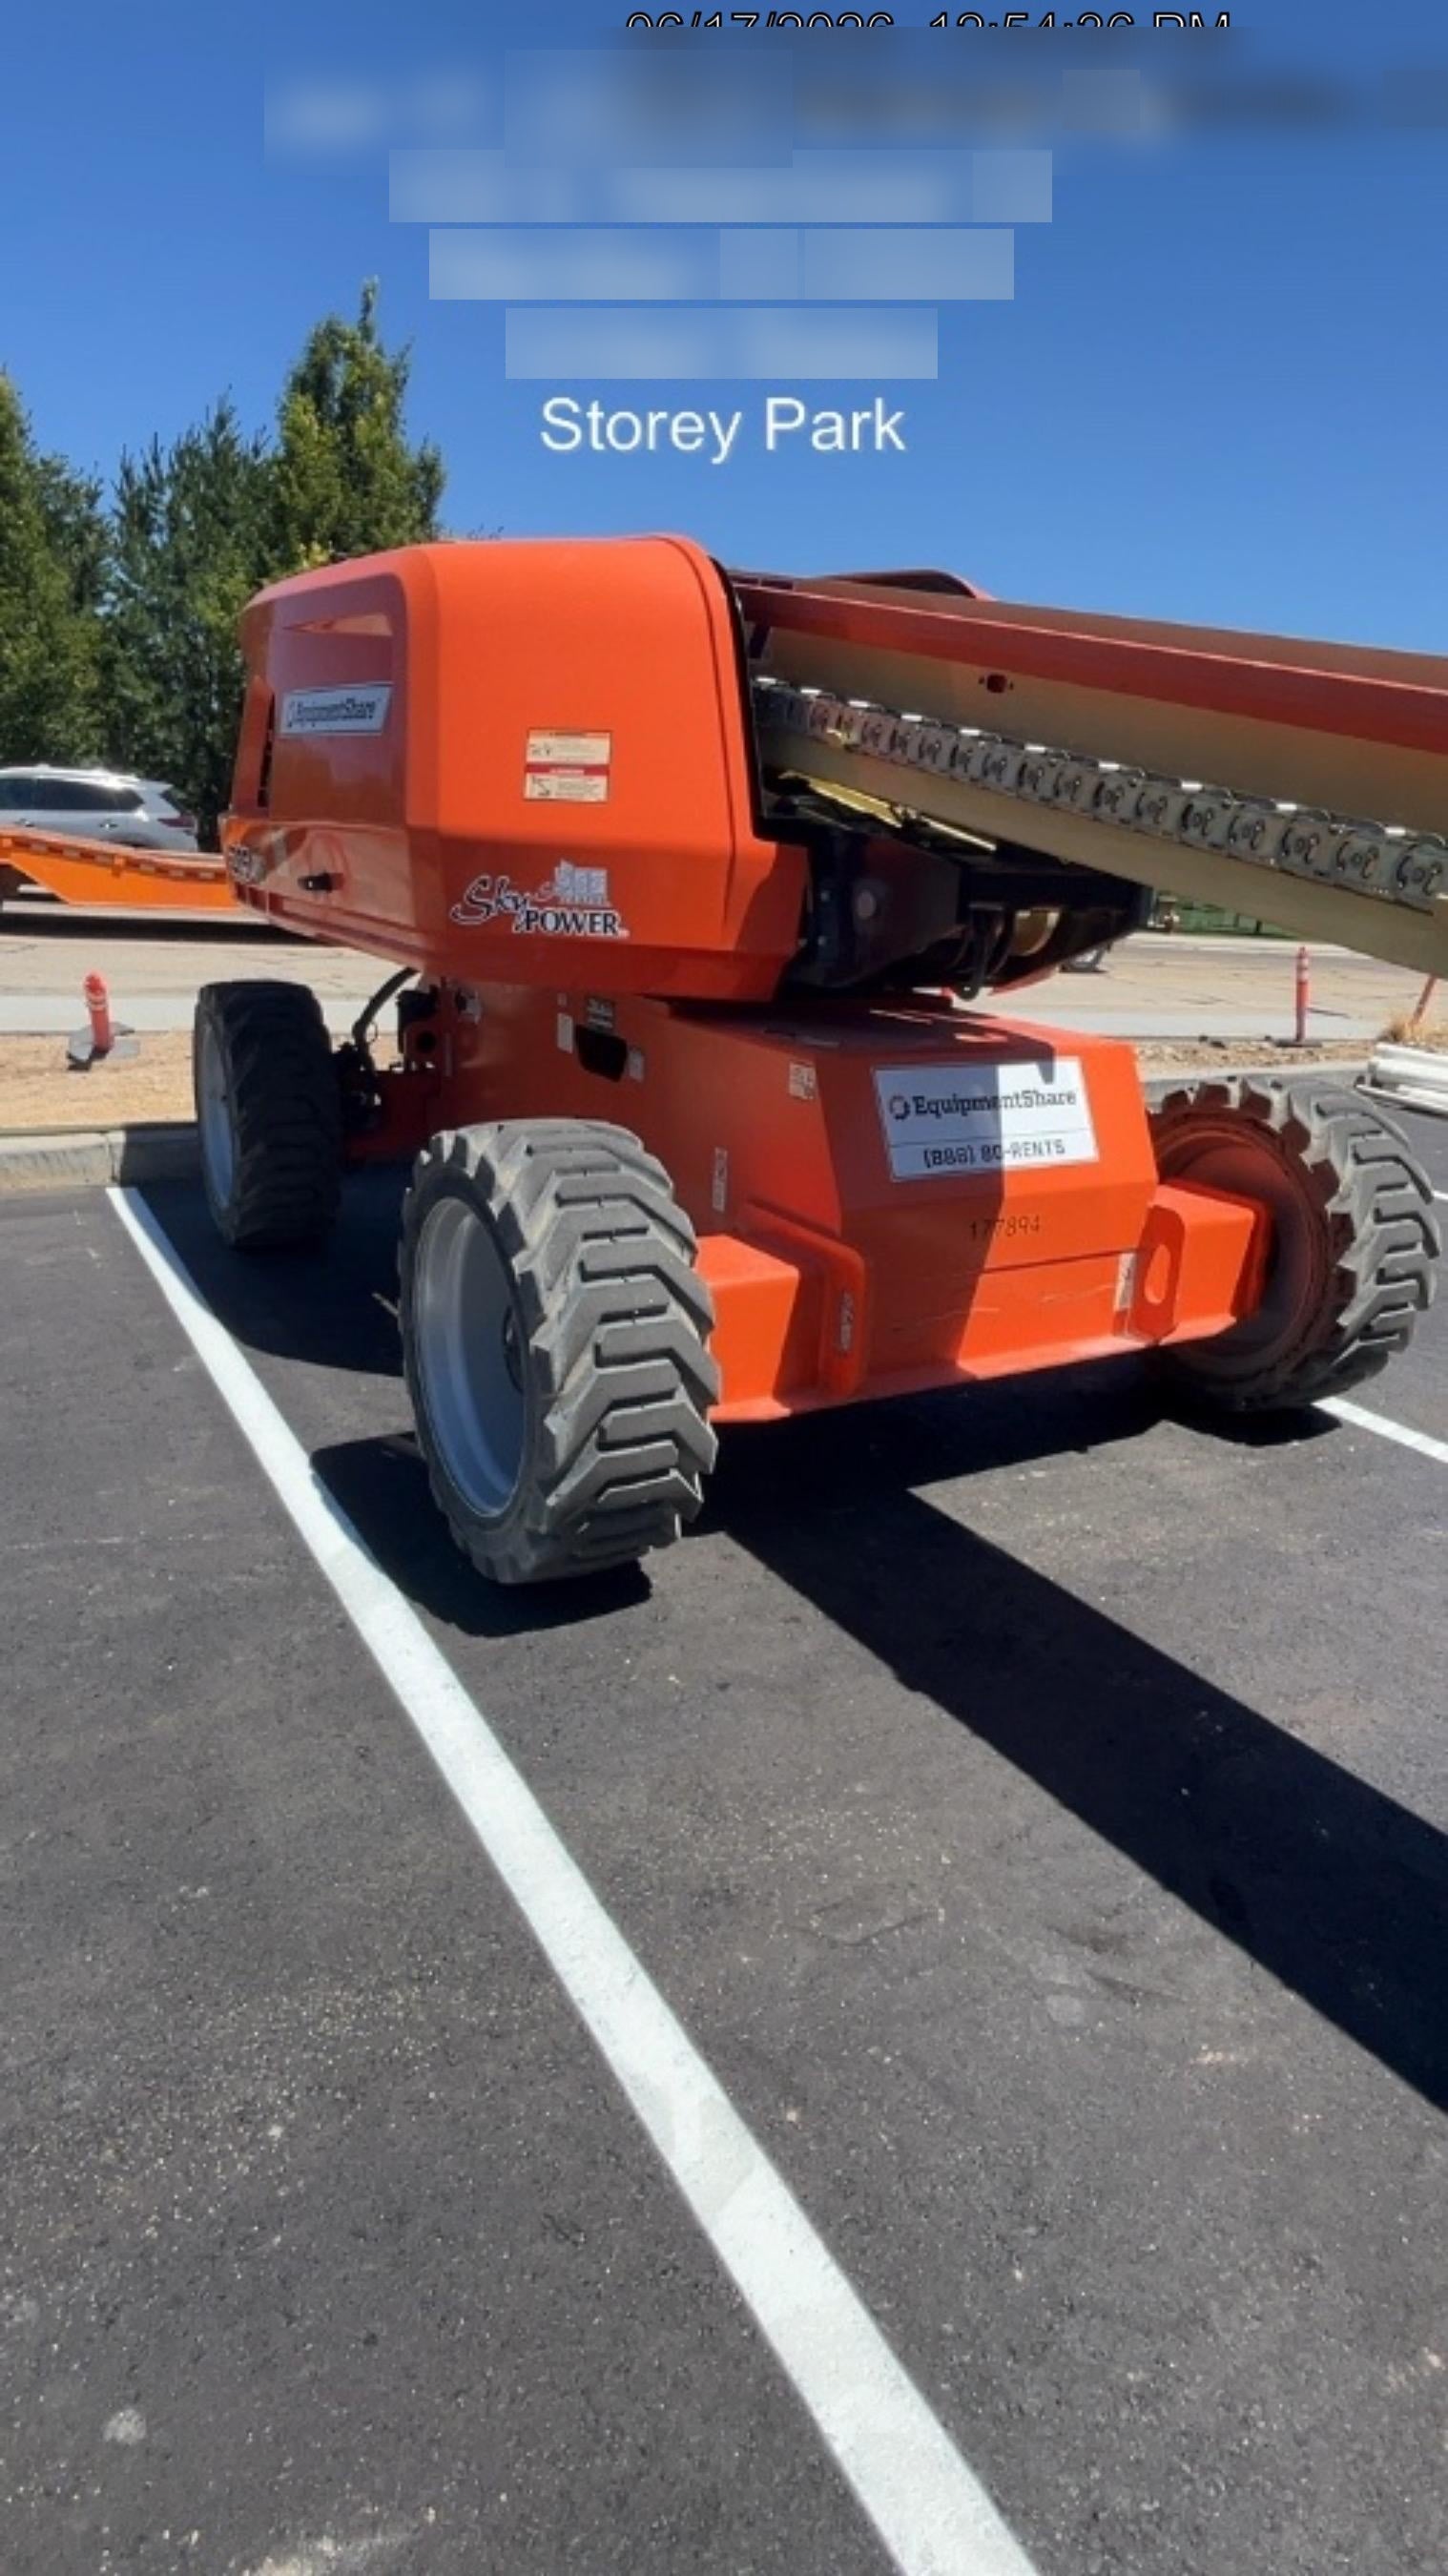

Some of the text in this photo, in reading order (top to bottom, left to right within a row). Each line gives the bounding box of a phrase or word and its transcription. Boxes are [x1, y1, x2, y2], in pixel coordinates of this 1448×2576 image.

[524, 908, 619, 937] POWER
[913, 1090, 1077, 1119] EquipmentShare
[922, 1149, 976, 1168] (888)
